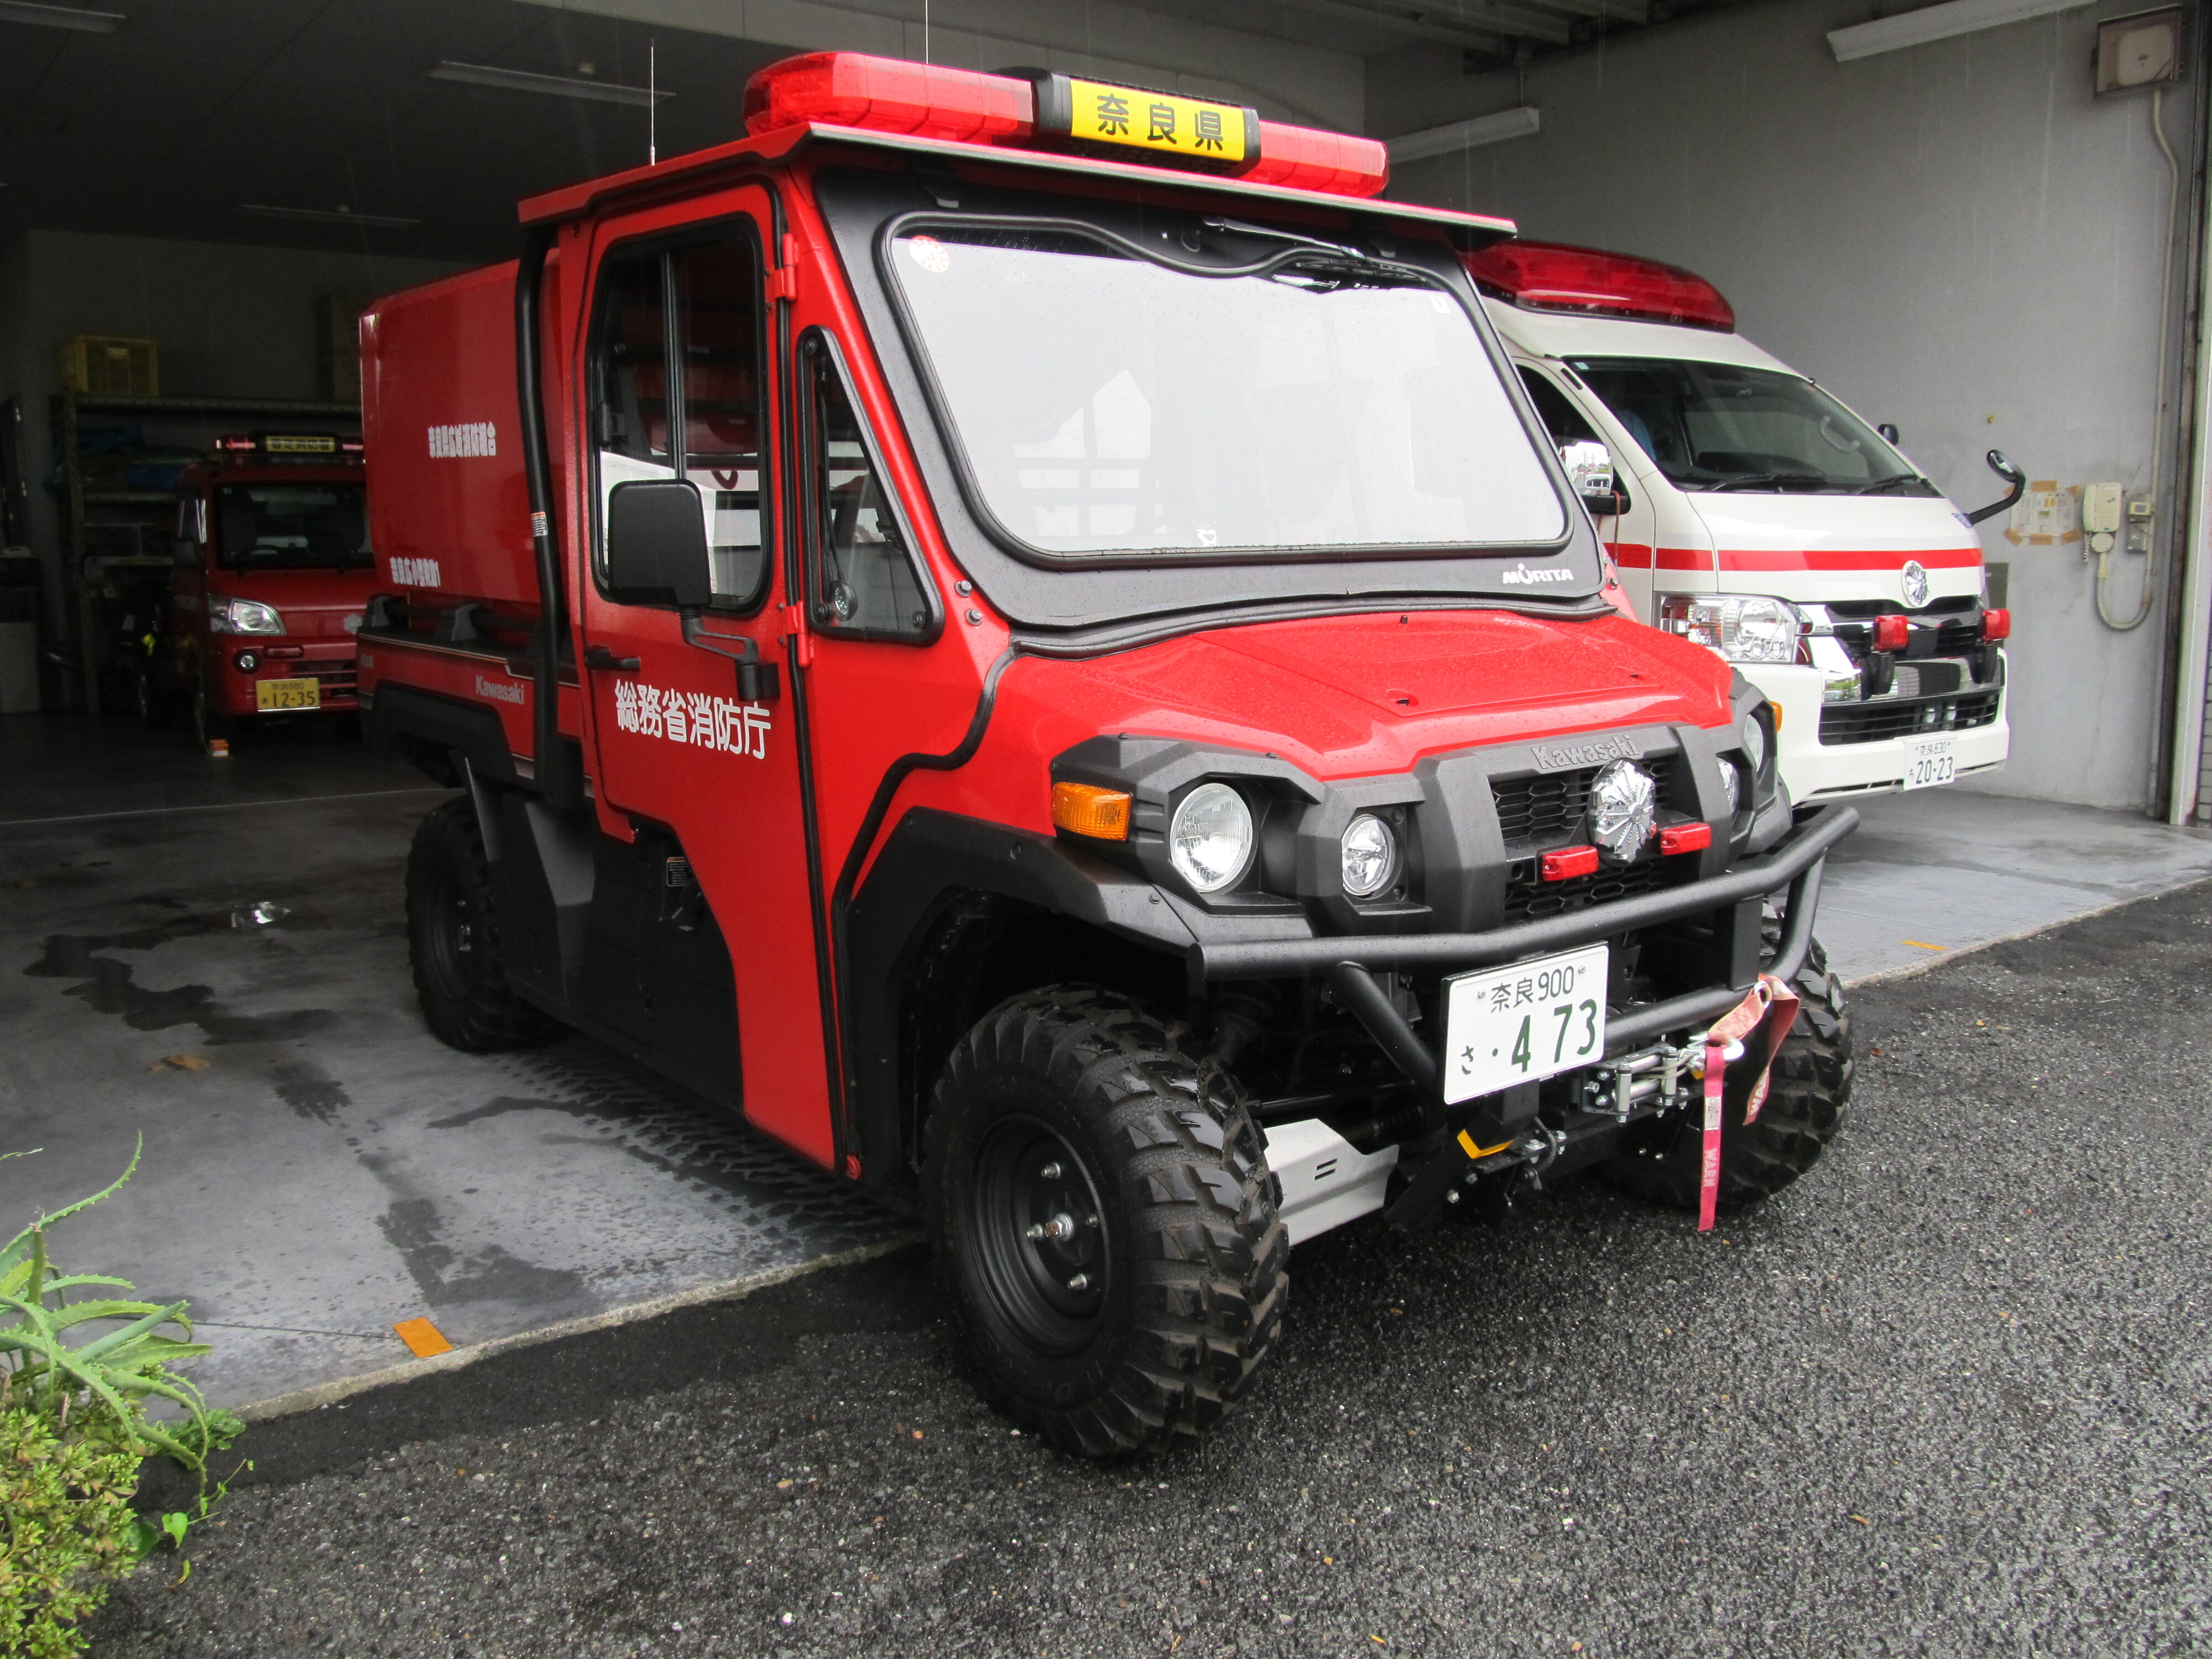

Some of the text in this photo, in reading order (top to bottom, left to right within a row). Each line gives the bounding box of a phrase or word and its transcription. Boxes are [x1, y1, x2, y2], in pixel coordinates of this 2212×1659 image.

[1097, 93, 1224, 151] 奈良県
[476, 675, 524, 705] Kawasaki
[614, 679, 771, 760] 総務省消防庁
[1531, 734, 1639, 769] Kawasaki
[1703, 1147, 1718, 1187] WARN
